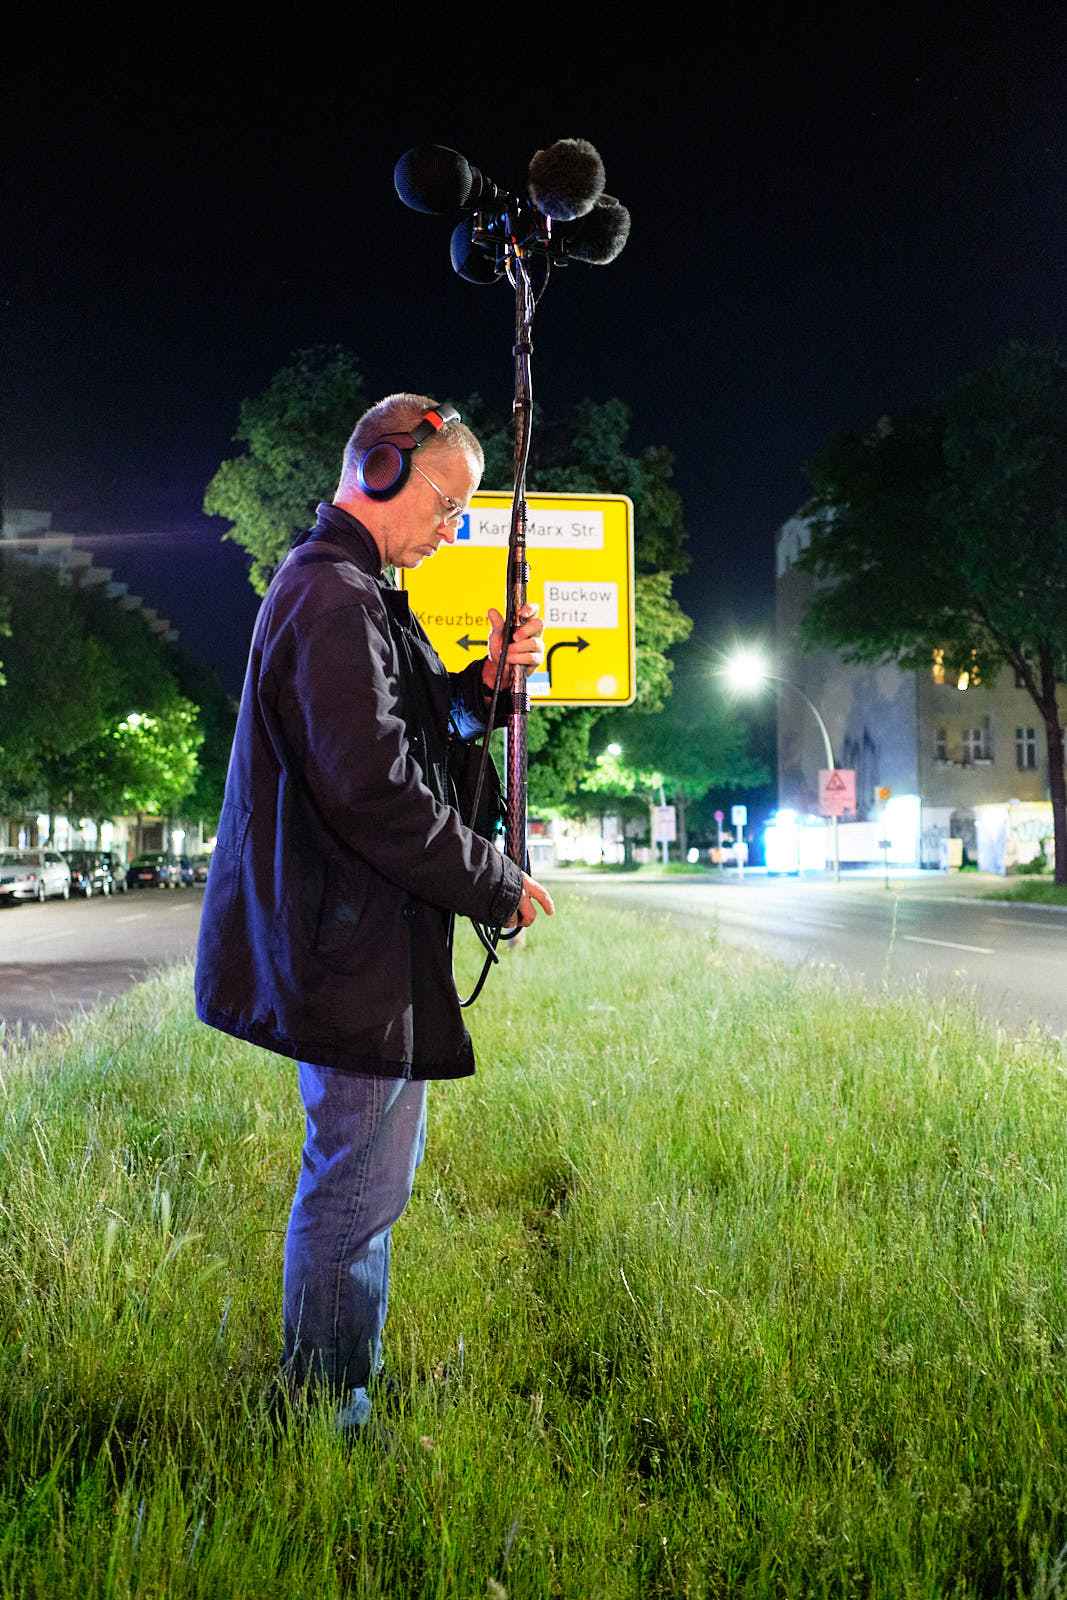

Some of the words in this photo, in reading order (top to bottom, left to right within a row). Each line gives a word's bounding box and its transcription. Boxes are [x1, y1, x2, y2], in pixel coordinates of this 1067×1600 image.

[549, 586, 612, 601] Buckow
[416, 611, 491, 627] Kreuzber
[549, 608, 588, 622] Britz
